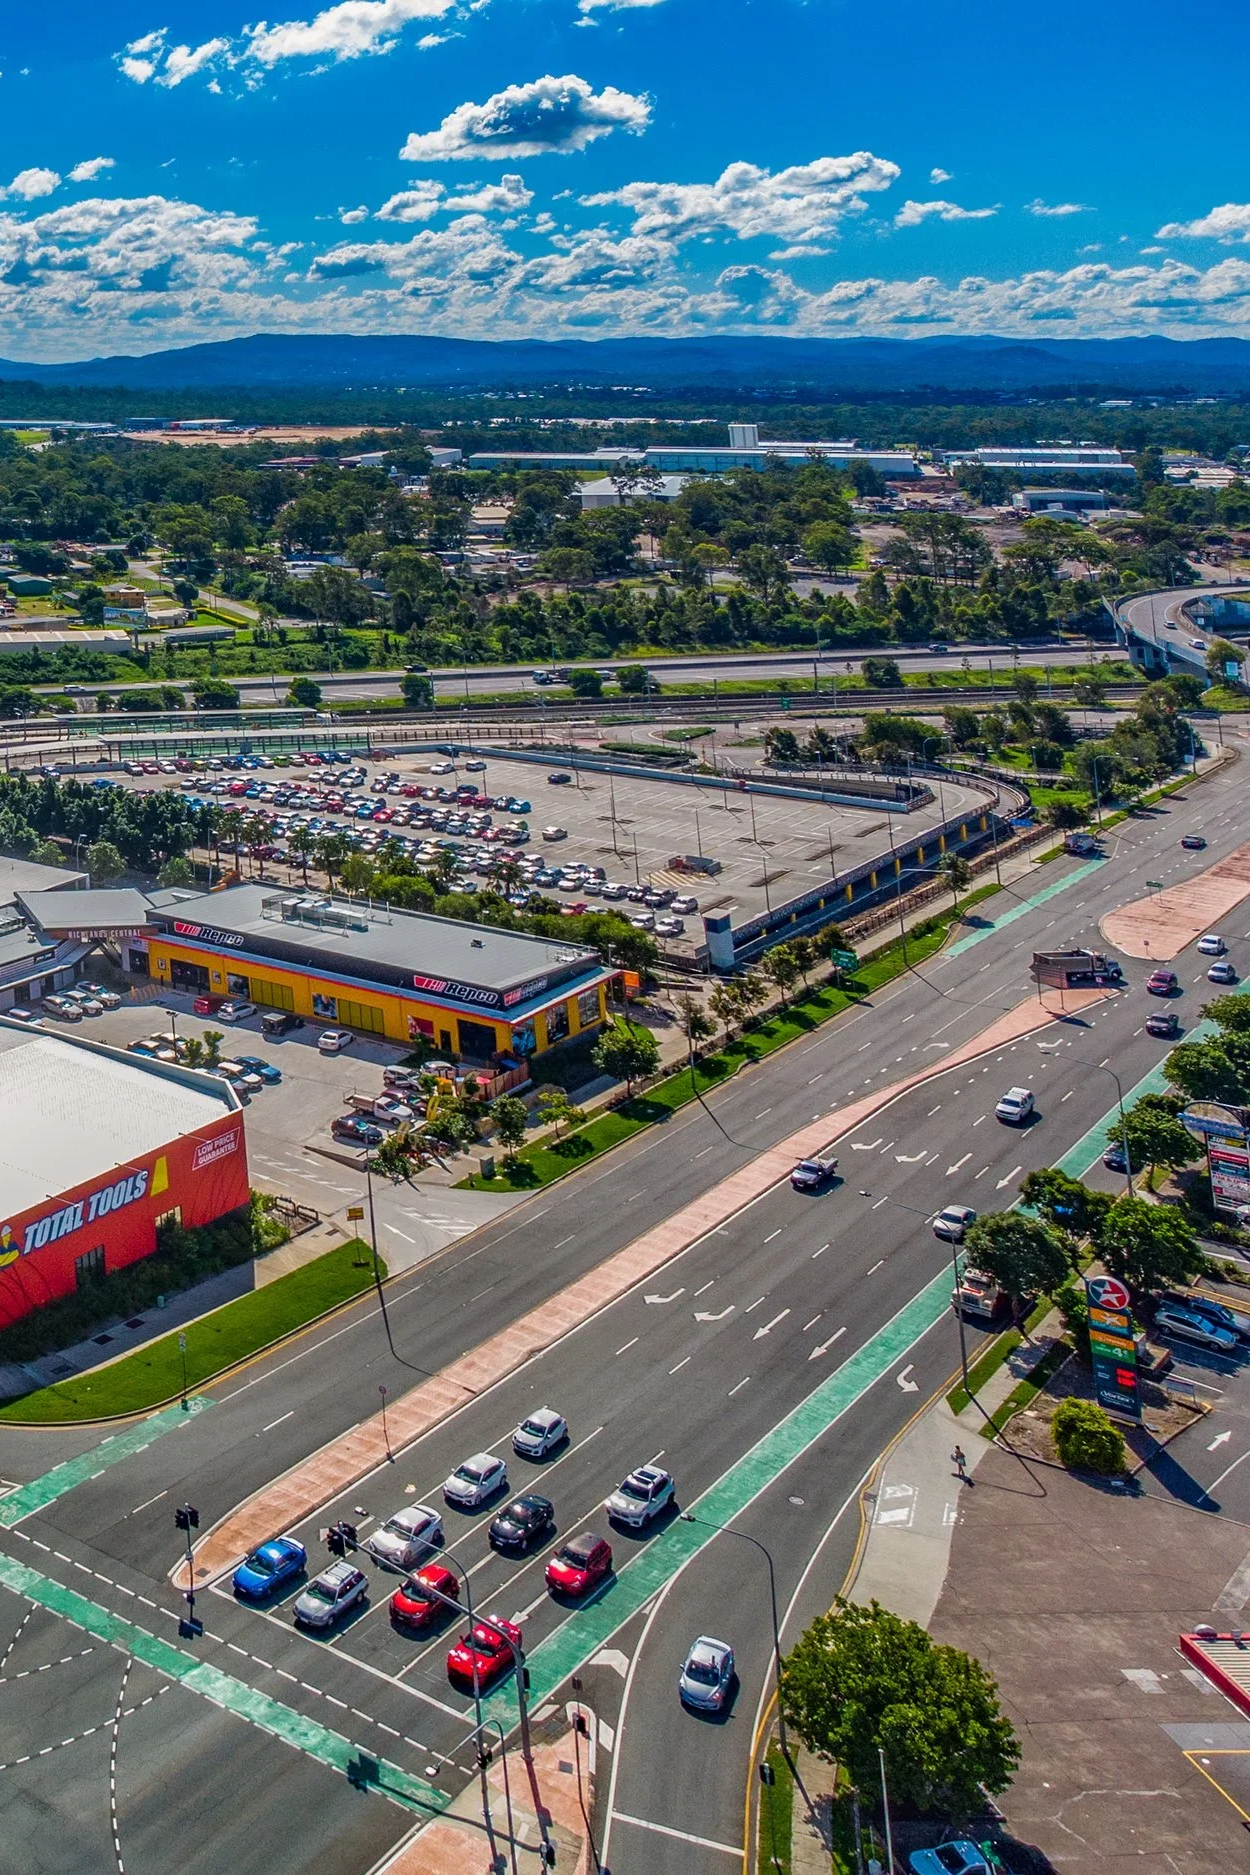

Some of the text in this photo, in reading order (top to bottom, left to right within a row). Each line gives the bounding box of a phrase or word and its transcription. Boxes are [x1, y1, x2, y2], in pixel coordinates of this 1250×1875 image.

[68, 928, 142, 939] RICHLANDS CENTRAL
[200, 926, 244, 946] Repco
[444, 981, 498, 1004] Repco
[197, 1132, 235, 1157] LOW PRICE
[198, 1141, 236, 1165] GUARANTEE
[23, 1170, 148, 1255] TOTAL TOOLS
